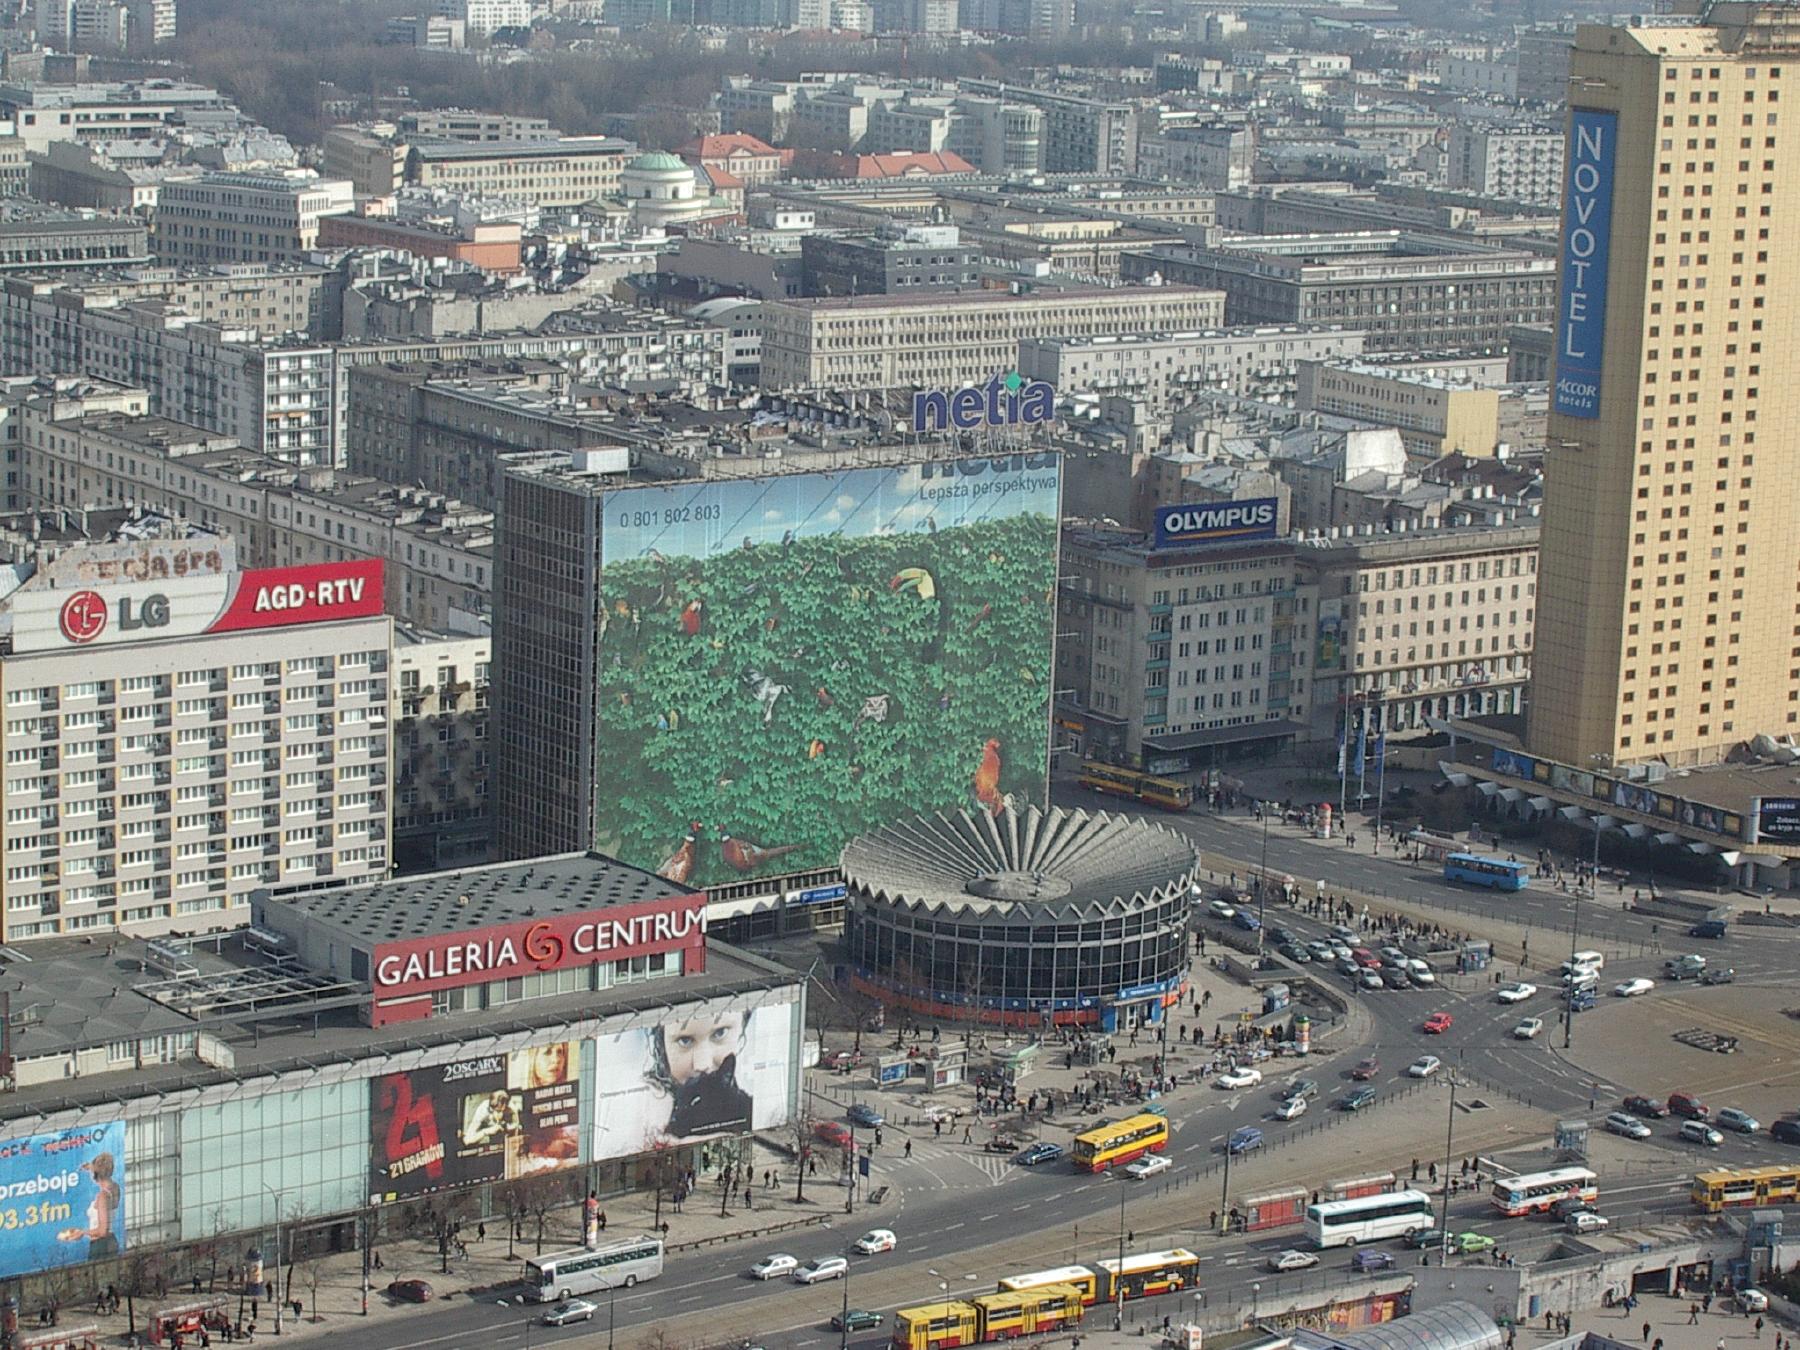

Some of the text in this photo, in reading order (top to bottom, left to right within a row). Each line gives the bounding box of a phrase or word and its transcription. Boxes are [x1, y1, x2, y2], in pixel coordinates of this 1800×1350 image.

[1566, 124, 1603, 359] NOVOTEL
[914, 370, 1056, 432] netia
[1556, 378, 1597, 397] ACCOR
[920, 475, 1057, 502] Lepsza perspektywa
[620, 504, 721, 528] 0 801 802 803
[1165, 504, 1273, 532] OLYMPUS
[119, 593, 170, 632] LG
[377, 906, 708, 986] GALERIA CENTRUM
